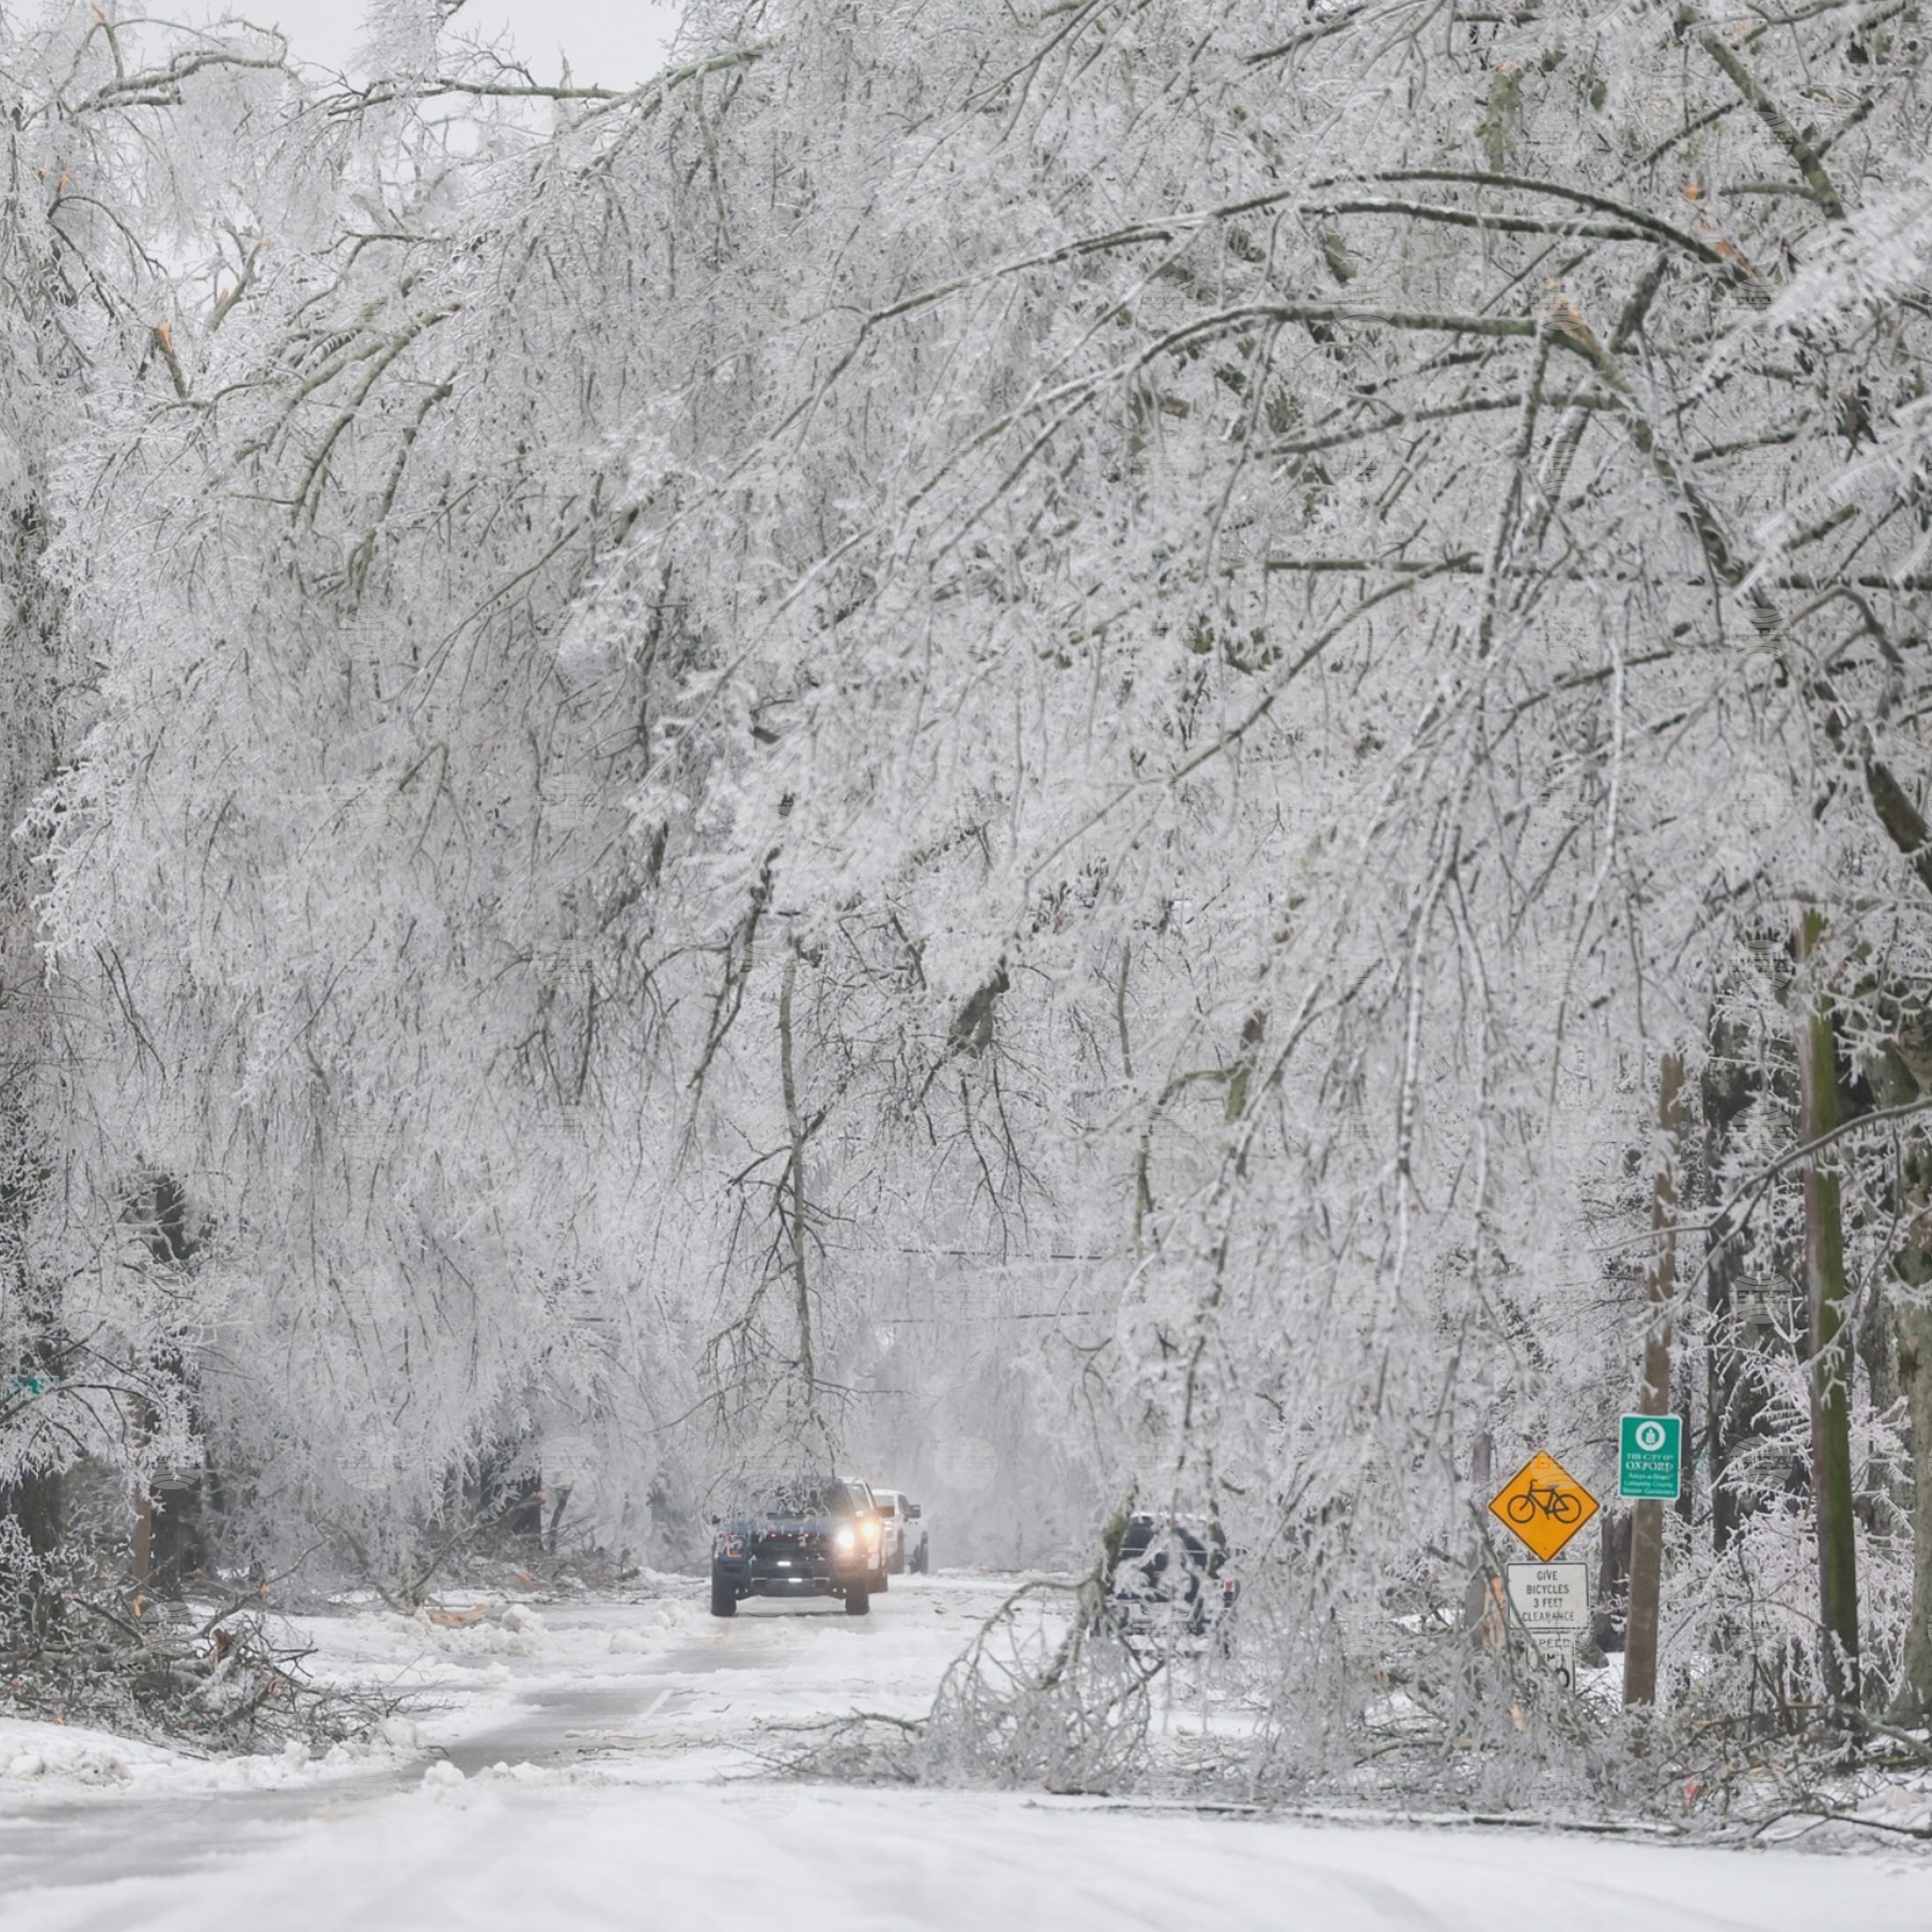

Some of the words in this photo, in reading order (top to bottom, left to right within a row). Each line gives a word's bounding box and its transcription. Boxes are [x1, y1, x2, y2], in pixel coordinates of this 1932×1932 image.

[1625, 1461, 1674, 1472] OXFORD
[1537, 1569, 1558, 1581] GIVE
[1526, 1584, 1569, 1595] BICYCLES
[1533, 1598, 1540, 1609] 3
[1542, 1597, 1563, 1609] FEET
[1523, 1611, 1575, 1622] CLEARANCE
